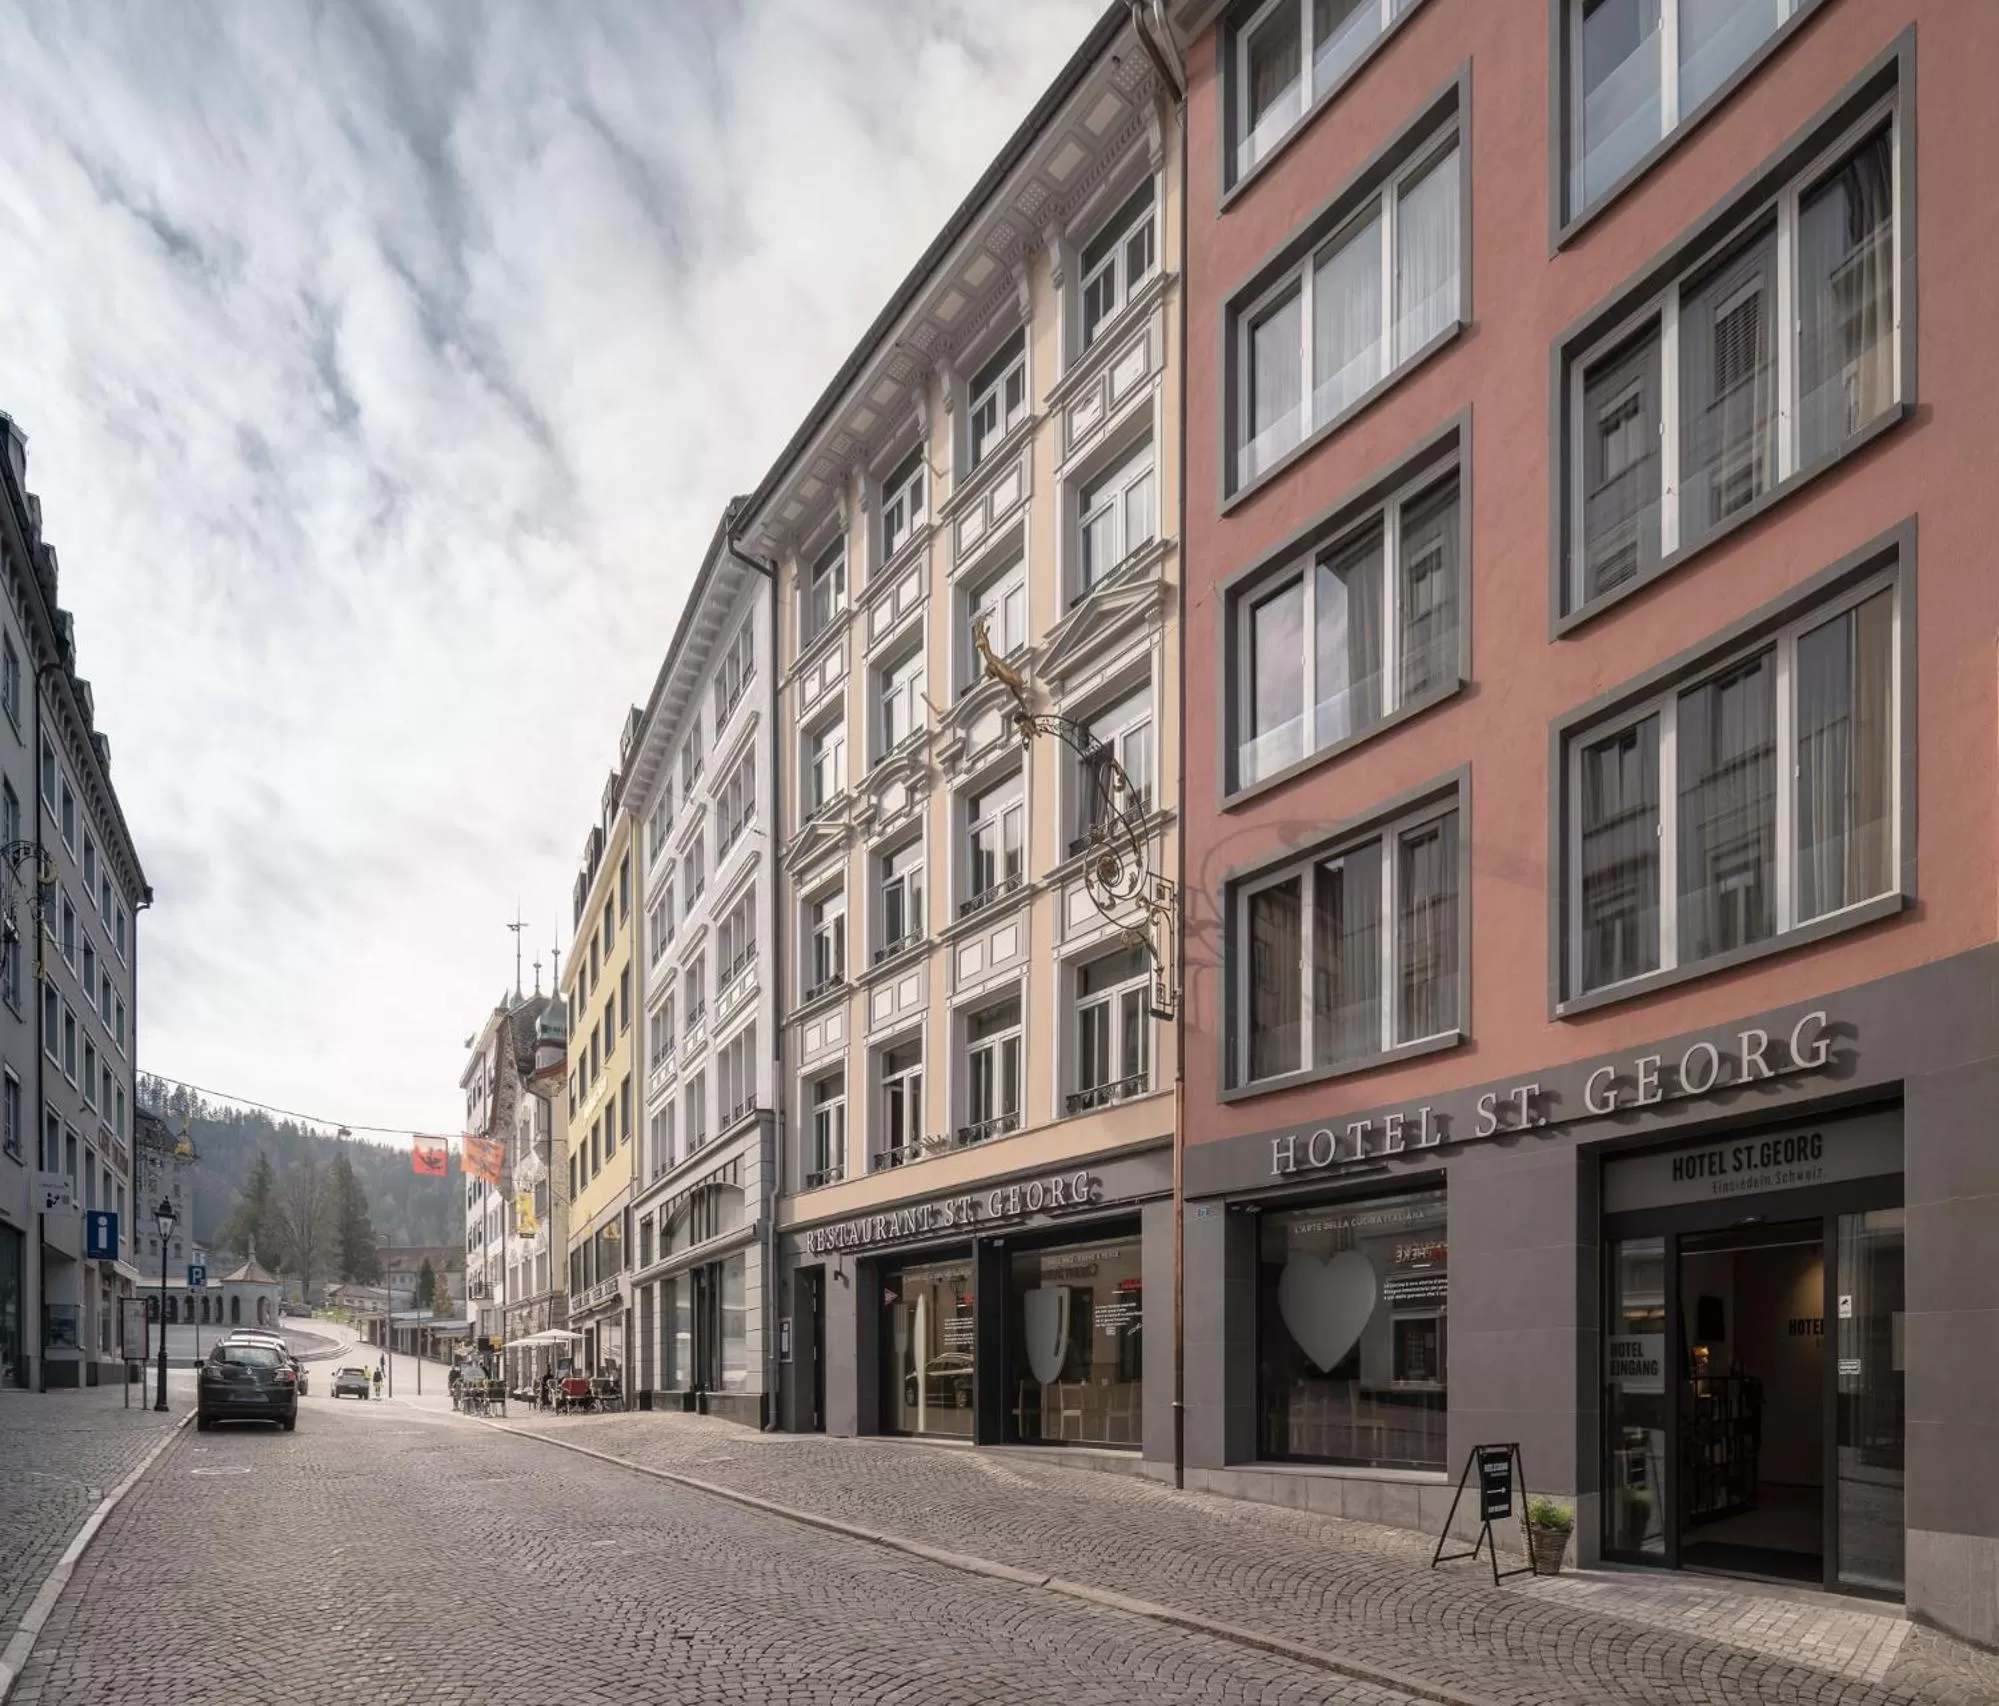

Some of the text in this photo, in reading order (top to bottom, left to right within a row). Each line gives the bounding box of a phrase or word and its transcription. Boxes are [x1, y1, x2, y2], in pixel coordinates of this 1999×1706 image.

[1270, 1011, 1832, 1175] HOTEL ST. GEORG
[1672, 1151, 1727, 1181] HOTEL
[806, 1171, 1090, 1253] RESTAURANT ST. GEORG
[1610, 1342, 1644, 1358] HOTEL
[1610, 1359, 1659, 1377] EINGANG
